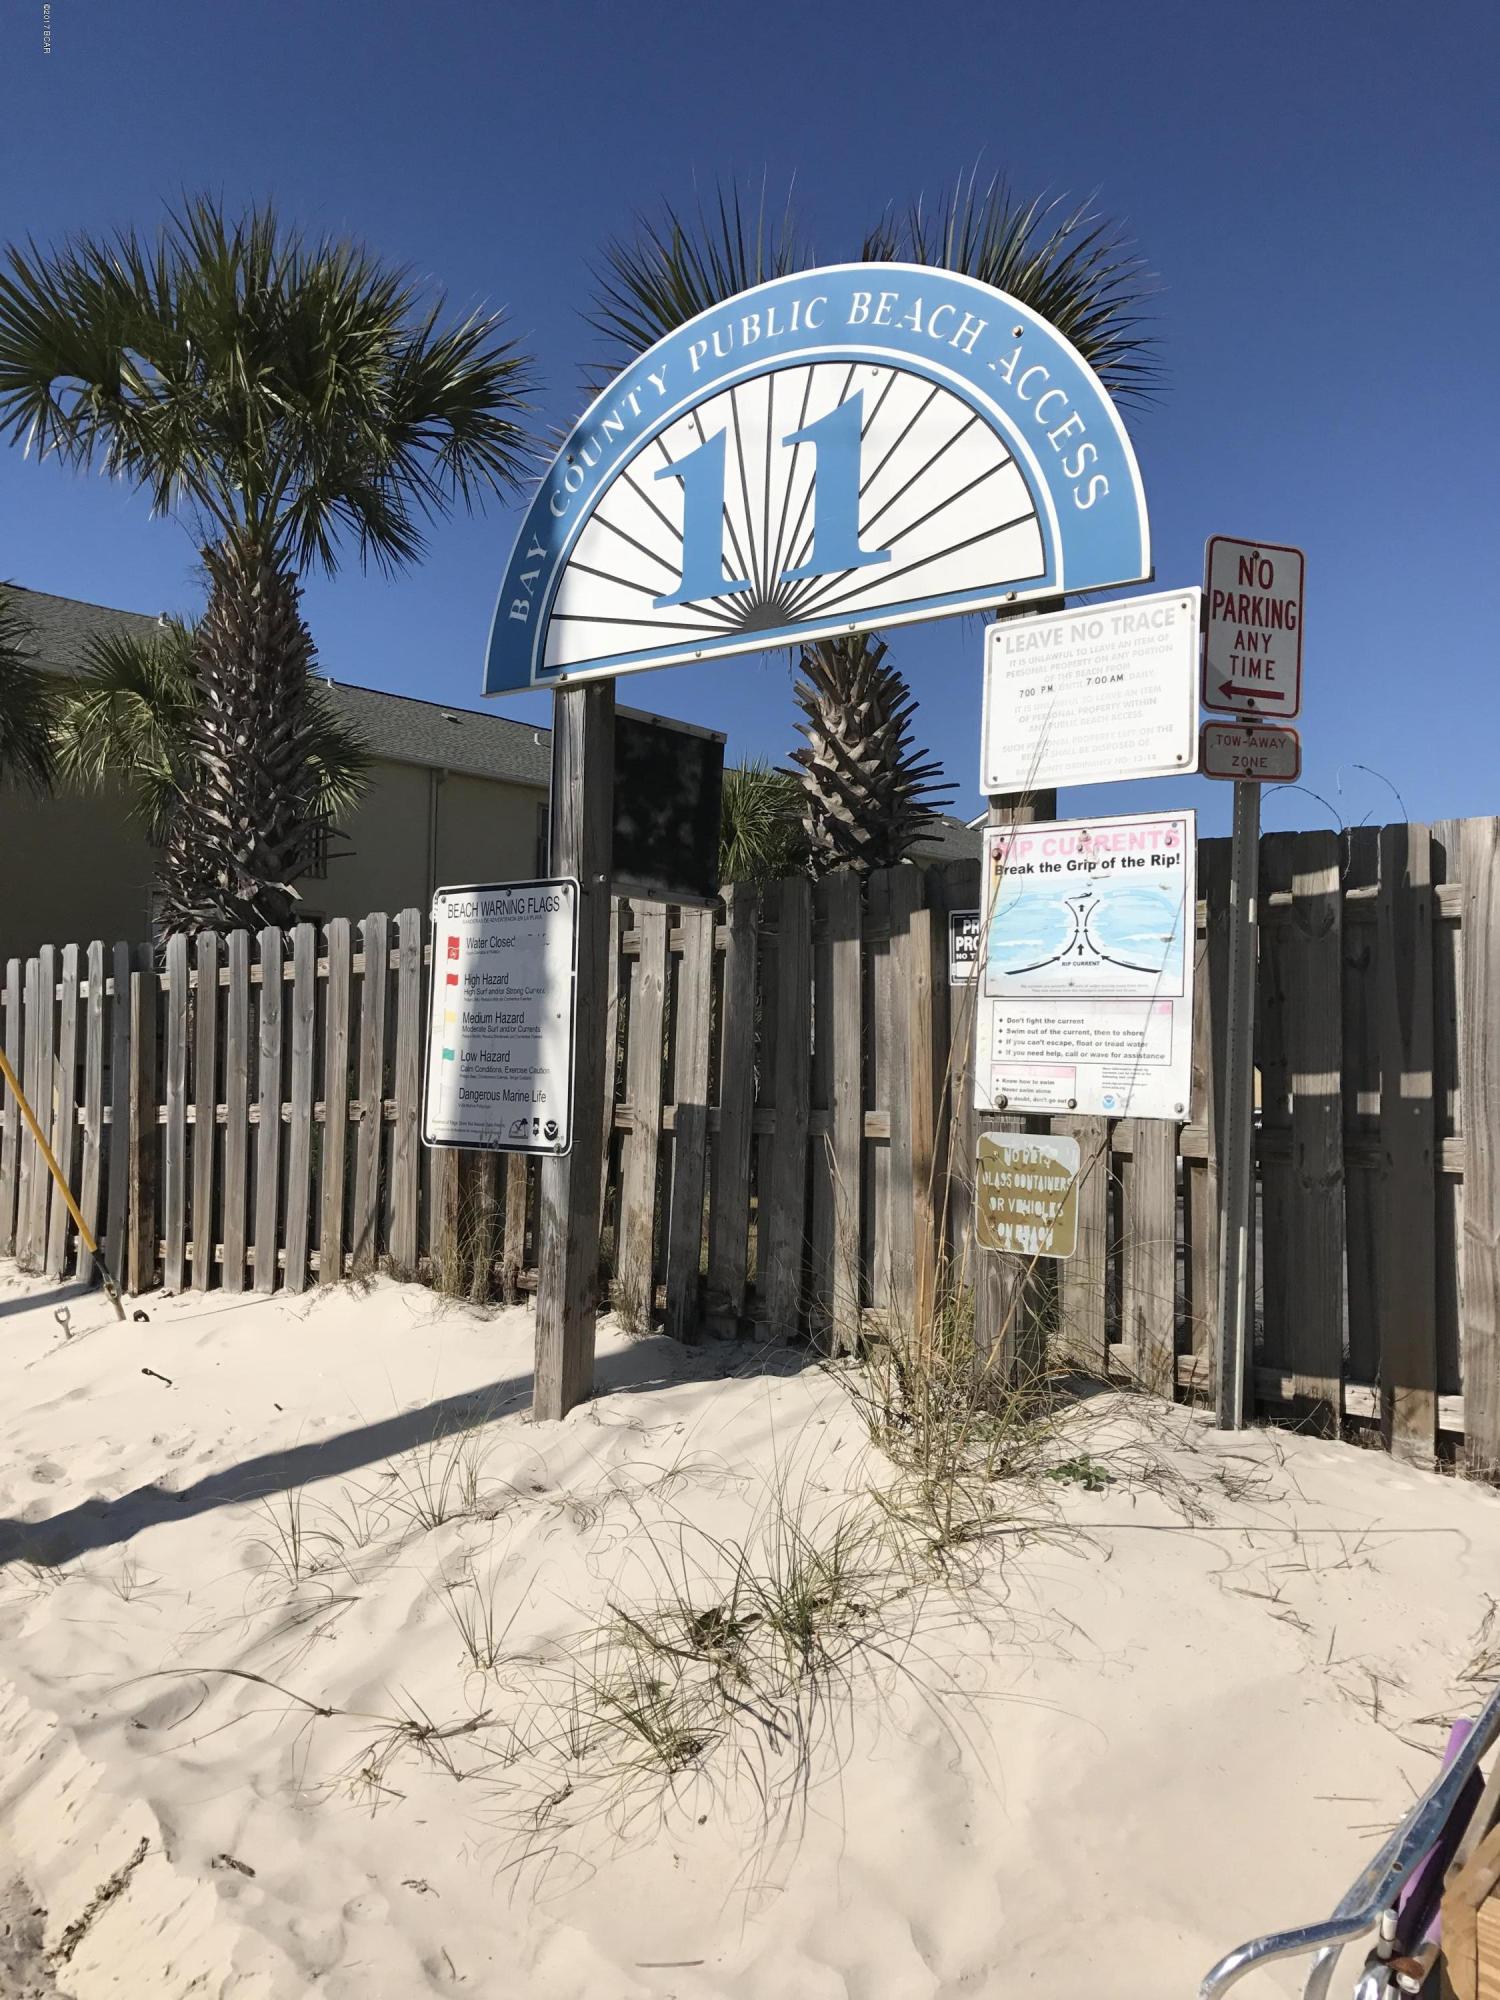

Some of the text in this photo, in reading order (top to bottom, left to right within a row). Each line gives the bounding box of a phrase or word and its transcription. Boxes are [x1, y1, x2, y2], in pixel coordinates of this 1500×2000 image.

[508, 292, 1110, 625] BAY COUNTY PUBLIC BEACH ACCESS
[653, 387, 892, 609] 11
[1238, 555, 1274, 590] NO
[1212, 589, 1297, 631] PARKING
[1006, 607, 1176, 655] LEAVE NO TRACE
[1234, 630, 1272, 654] ANY
[1229, 655, 1276, 681] TIME
[1216, 734, 1287, 749] TOW-AWAY
[1232, 755, 1268, 768] ZONE
[1042, 829, 1180, 857] CURRENTS
[994, 853, 1180, 876] Break the Grip of the Rip!
[447, 895, 560, 919] BEACH WARNING FLAGS
[466, 936, 488, 949] Water
[489, 935, 516, 948] Closed
[464, 972, 509, 988] High Hazard
[462, 1011, 525, 1024] Medium Hazard
[460, 1050, 510, 1063] Low Hazard
[458, 1087, 547, 1103] Dangerous Marine Life
[989, 1196, 1005, 1211] OR
